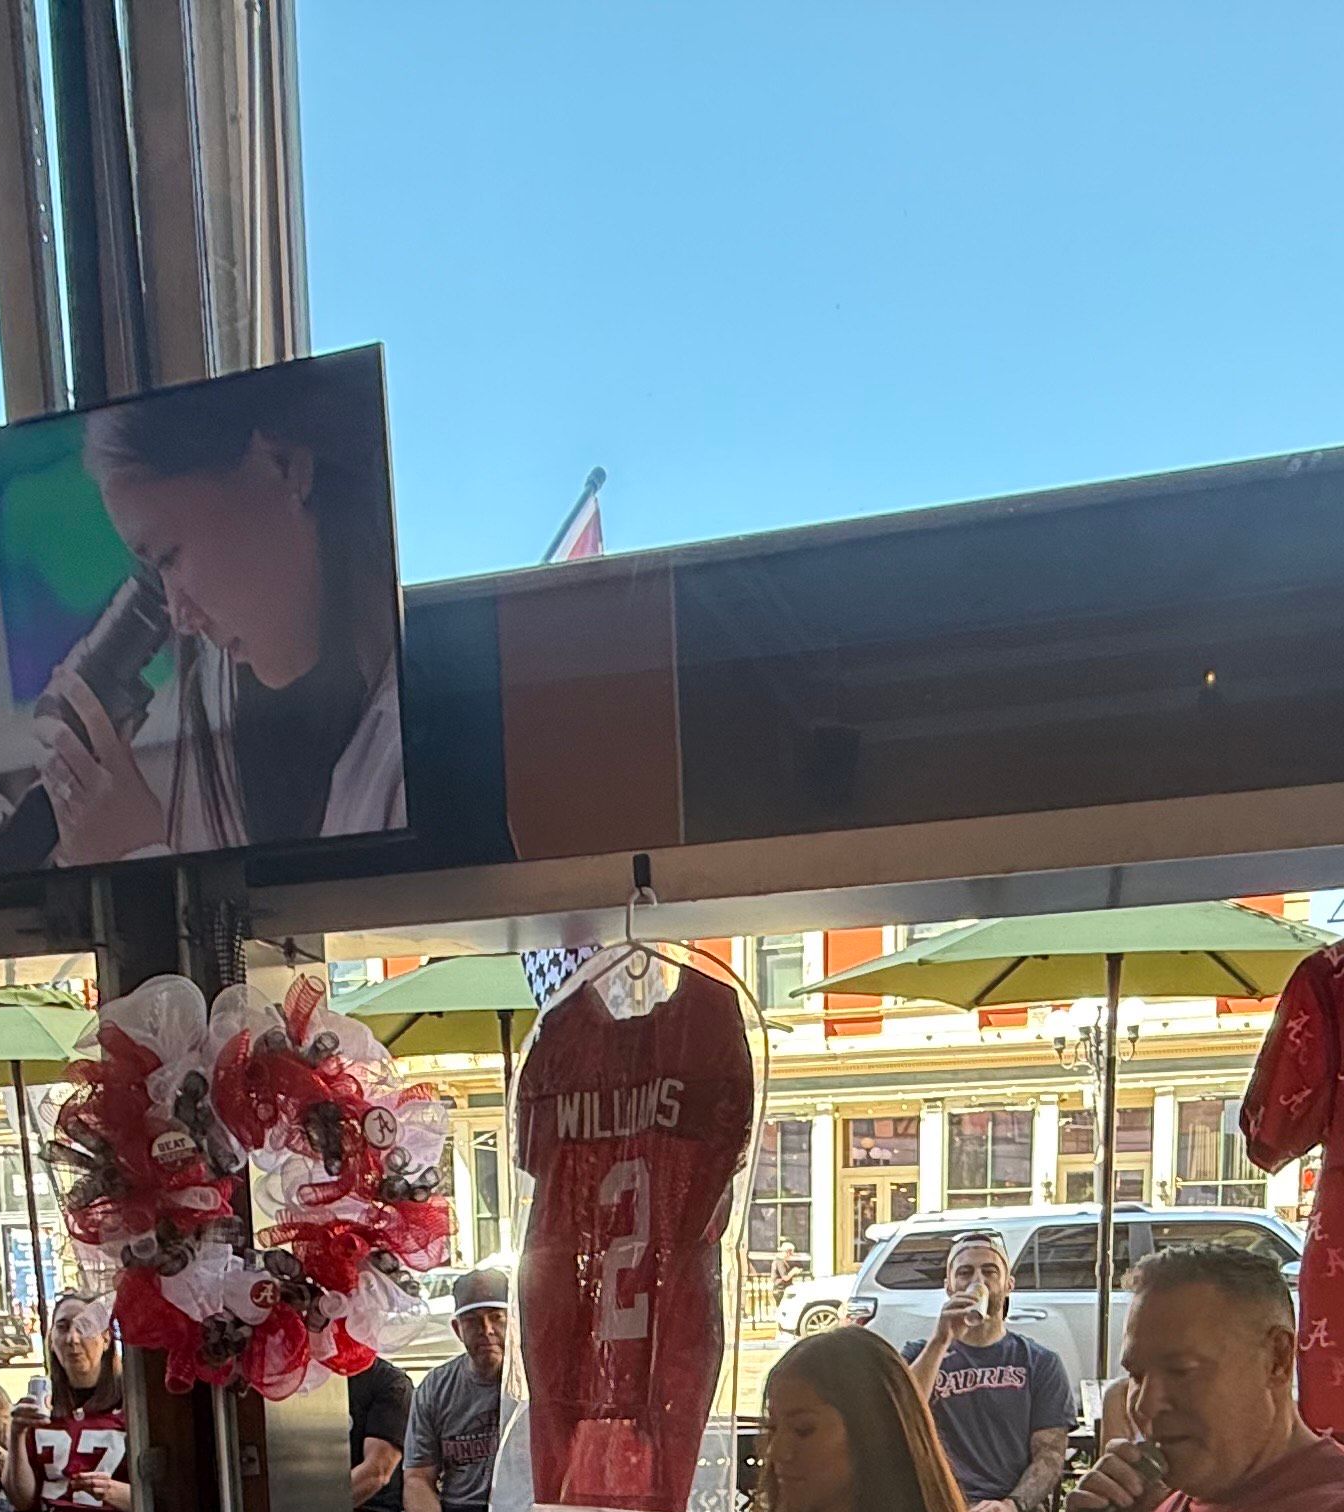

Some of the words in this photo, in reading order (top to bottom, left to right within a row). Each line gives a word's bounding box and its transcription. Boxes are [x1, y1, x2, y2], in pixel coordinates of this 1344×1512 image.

[157, 1138, 186, 1152] BEAT
[599, 1156, 650, 1340] 2
[35, 1429, 127, 1507] 37
